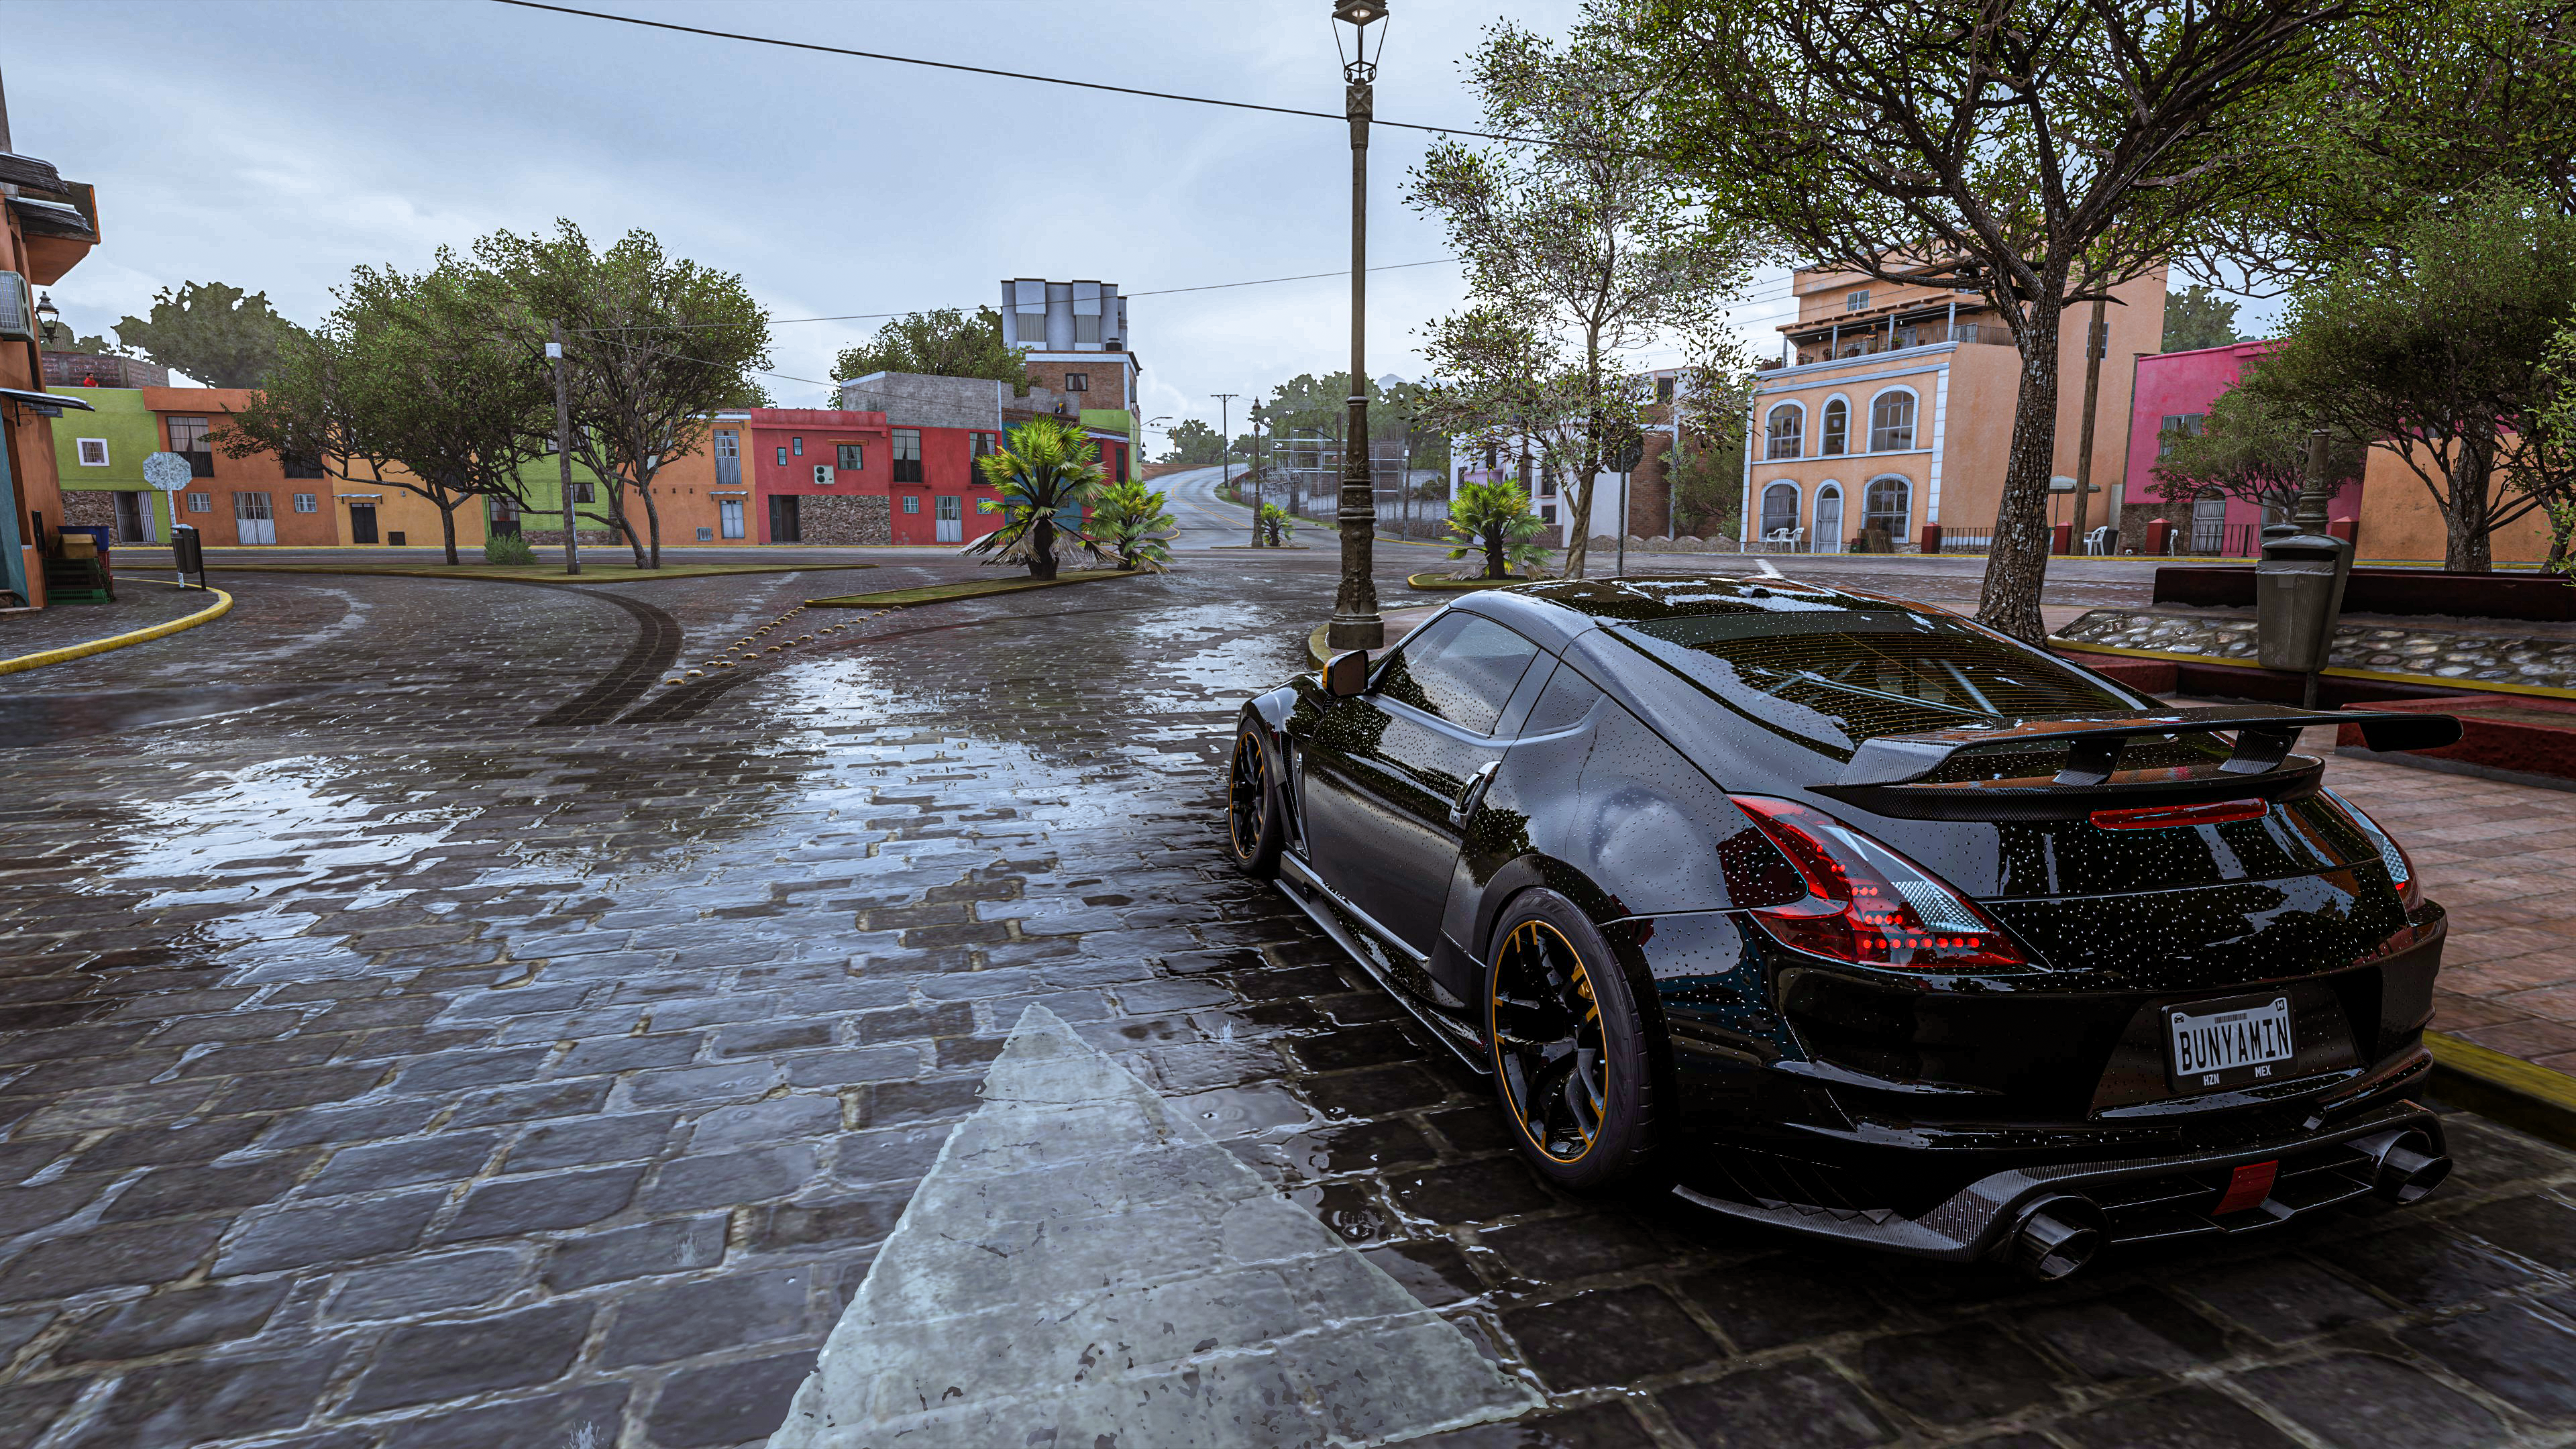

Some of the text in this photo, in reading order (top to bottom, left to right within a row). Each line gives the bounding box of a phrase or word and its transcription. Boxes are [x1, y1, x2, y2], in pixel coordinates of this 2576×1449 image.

[2276, 1000, 2284, 1011] H
[2179, 1016, 2290, 1071] BUNYAMIN
[2203, 1065, 2271, 1086] HZN MEX
